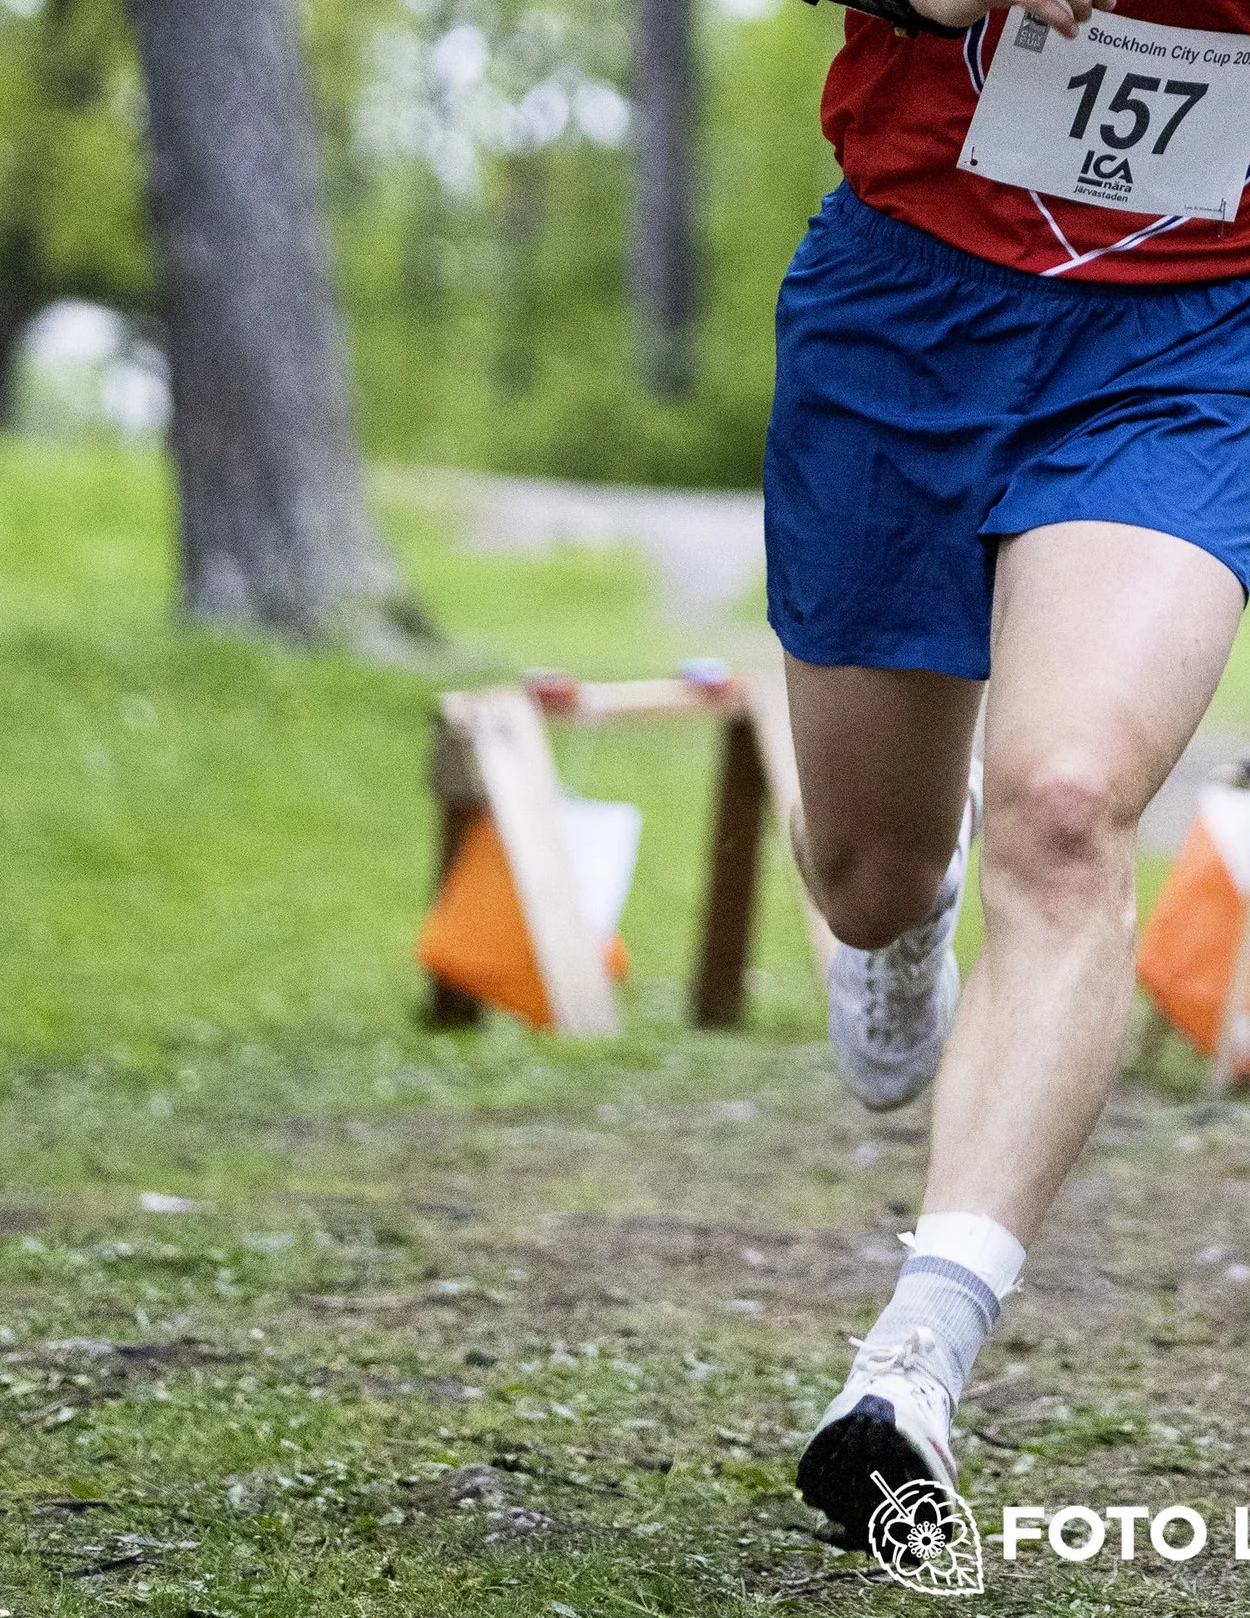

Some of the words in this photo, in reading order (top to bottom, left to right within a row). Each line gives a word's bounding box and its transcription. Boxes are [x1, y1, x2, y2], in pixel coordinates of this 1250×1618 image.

[1087, 27, 1168, 58] Stockholm
[1170, 45, 1200, 65] City
[1203, 49, 1231, 67] Cup
[1066, 63, 1210, 155] 157
[1080, 149, 1134, 184] ICA
[1073, 184, 1129, 203] Järvastaden
[1103, 180, 1132, 193] nära
